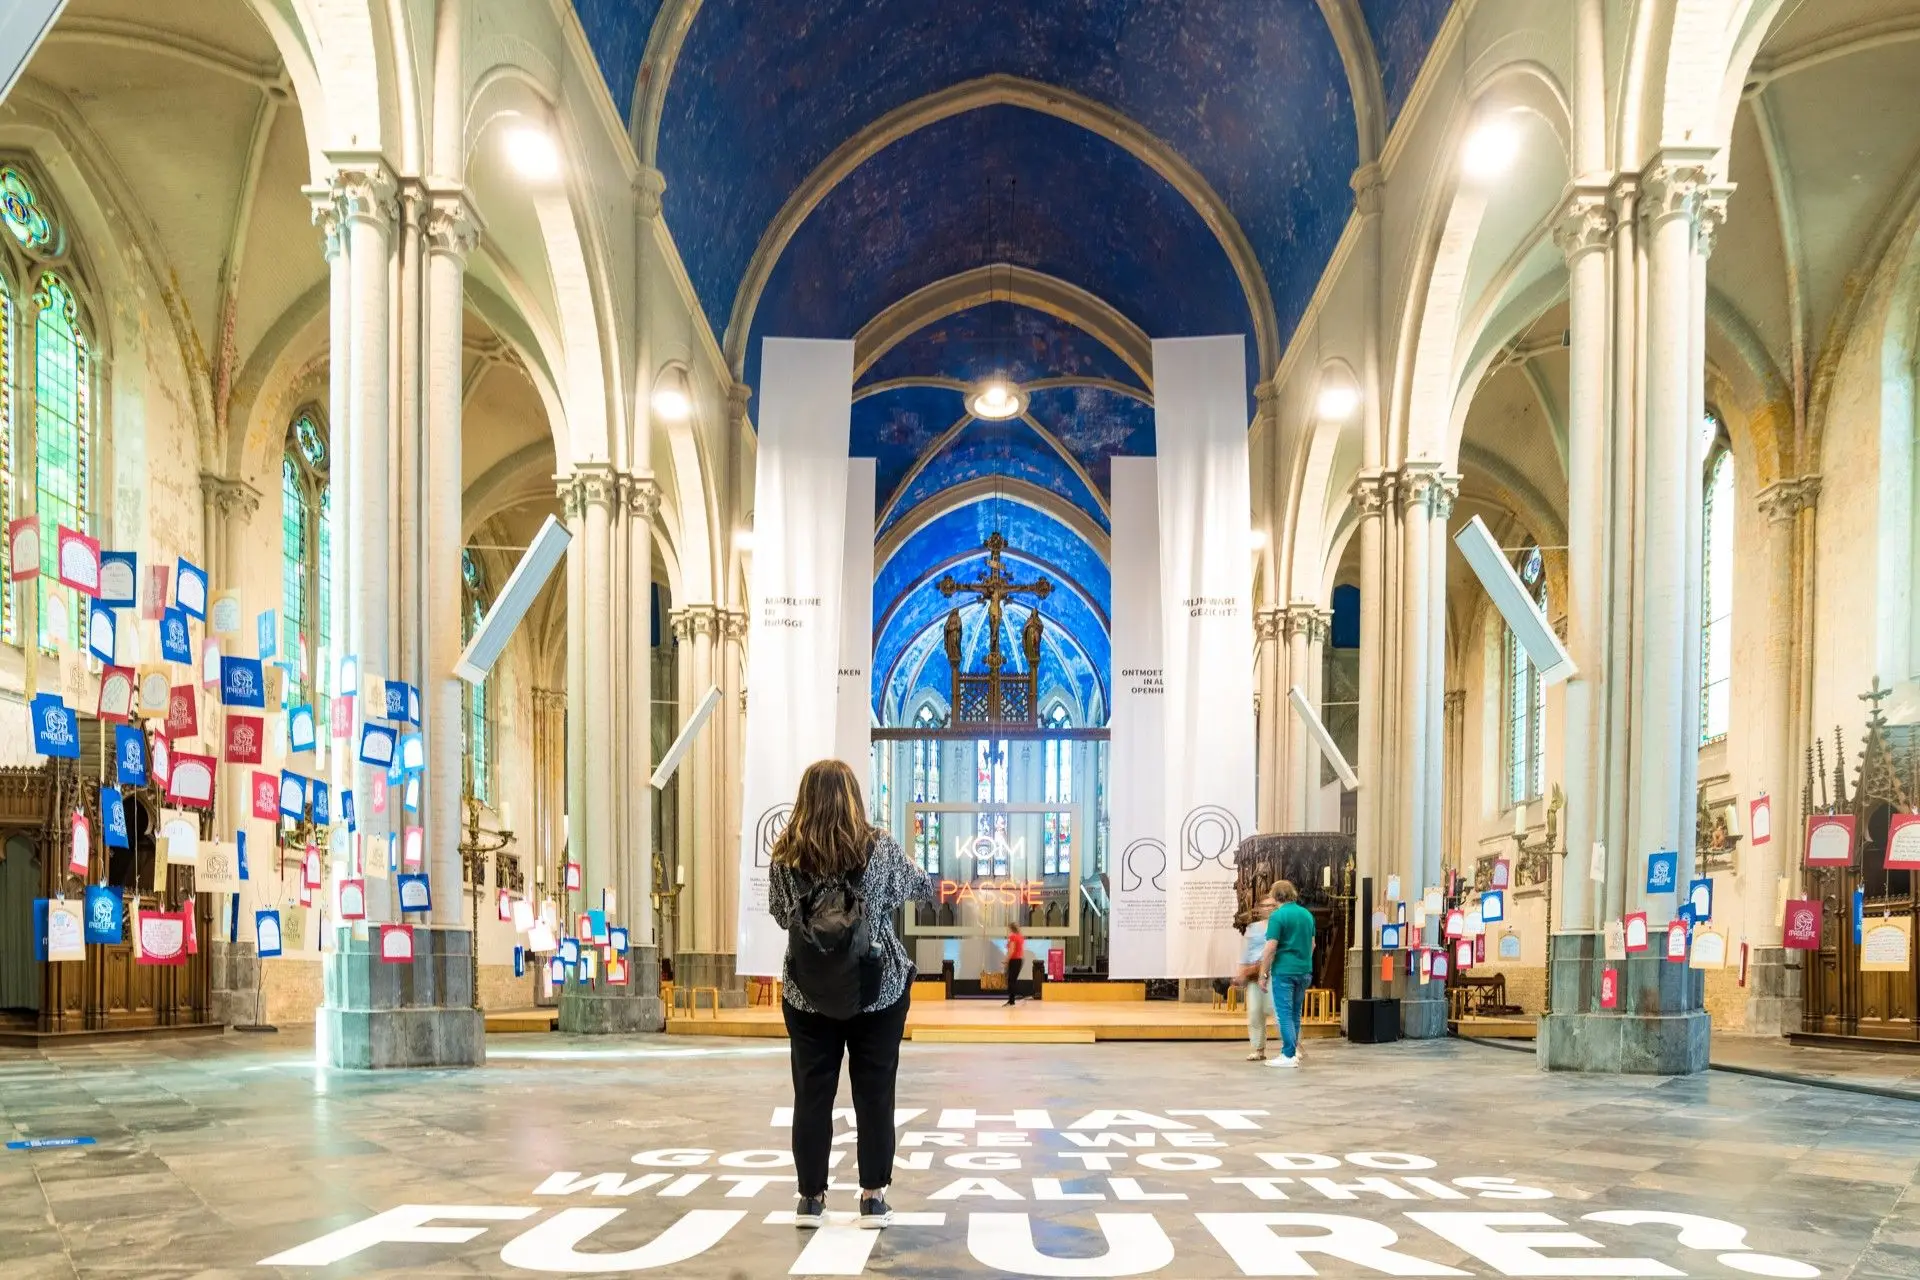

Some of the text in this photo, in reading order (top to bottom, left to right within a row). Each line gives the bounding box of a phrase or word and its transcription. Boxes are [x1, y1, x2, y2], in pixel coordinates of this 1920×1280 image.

[765, 597, 822, 607] MADELEINE
[955, 835, 1025, 859] KOM
[940, 880, 1044, 905] PASSIE
[1059, 1131, 1229, 1147] WE
[1057, 1151, 1223, 1171] TO
[1254, 1151, 1438, 1170] DO
[926, 1177, 1189, 1200] ALL
[1210, 1175, 1554, 1200] THIS
[256, 1203, 1822, 1279] FUTURE?
